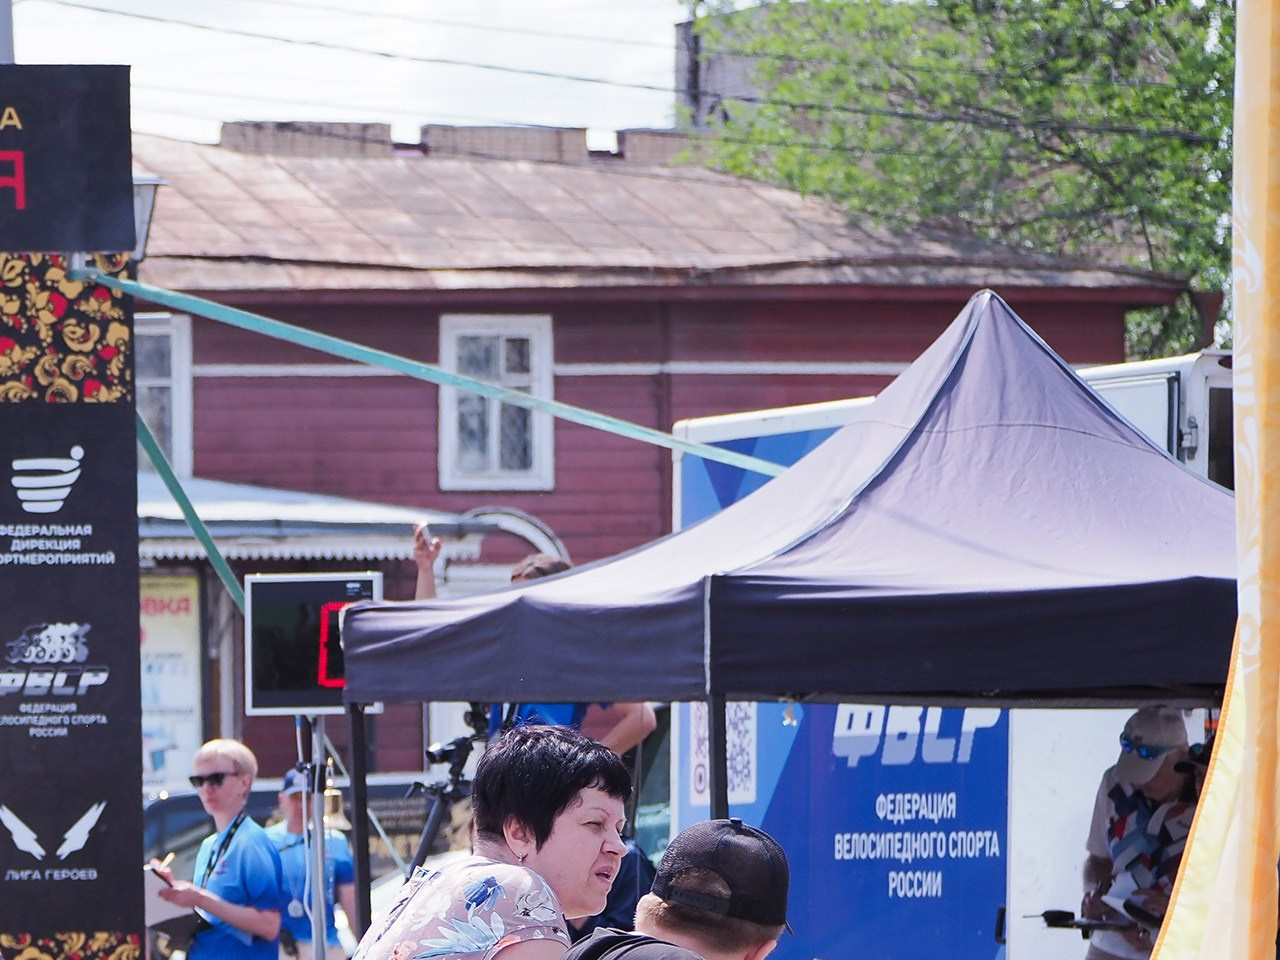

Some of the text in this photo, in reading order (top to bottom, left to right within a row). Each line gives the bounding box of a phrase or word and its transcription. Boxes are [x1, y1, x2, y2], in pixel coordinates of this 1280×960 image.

[10, 539, 81, 551] ДИРЕКЦИЯ
[19, 703, 77, 713] ФЕДЕРАЦИЯ
[29, 727, 68, 737] РОССИИ
[876, 792, 956, 825] ФЕДЕРАЦИЯ
[834, 831, 1000, 863] ВЕЛОСИПЕДНОГО СПОРТА
[5, 868, 98, 880] ЛИГА ГЕРОЕВ
[888, 871, 942, 898] РОССИИ
